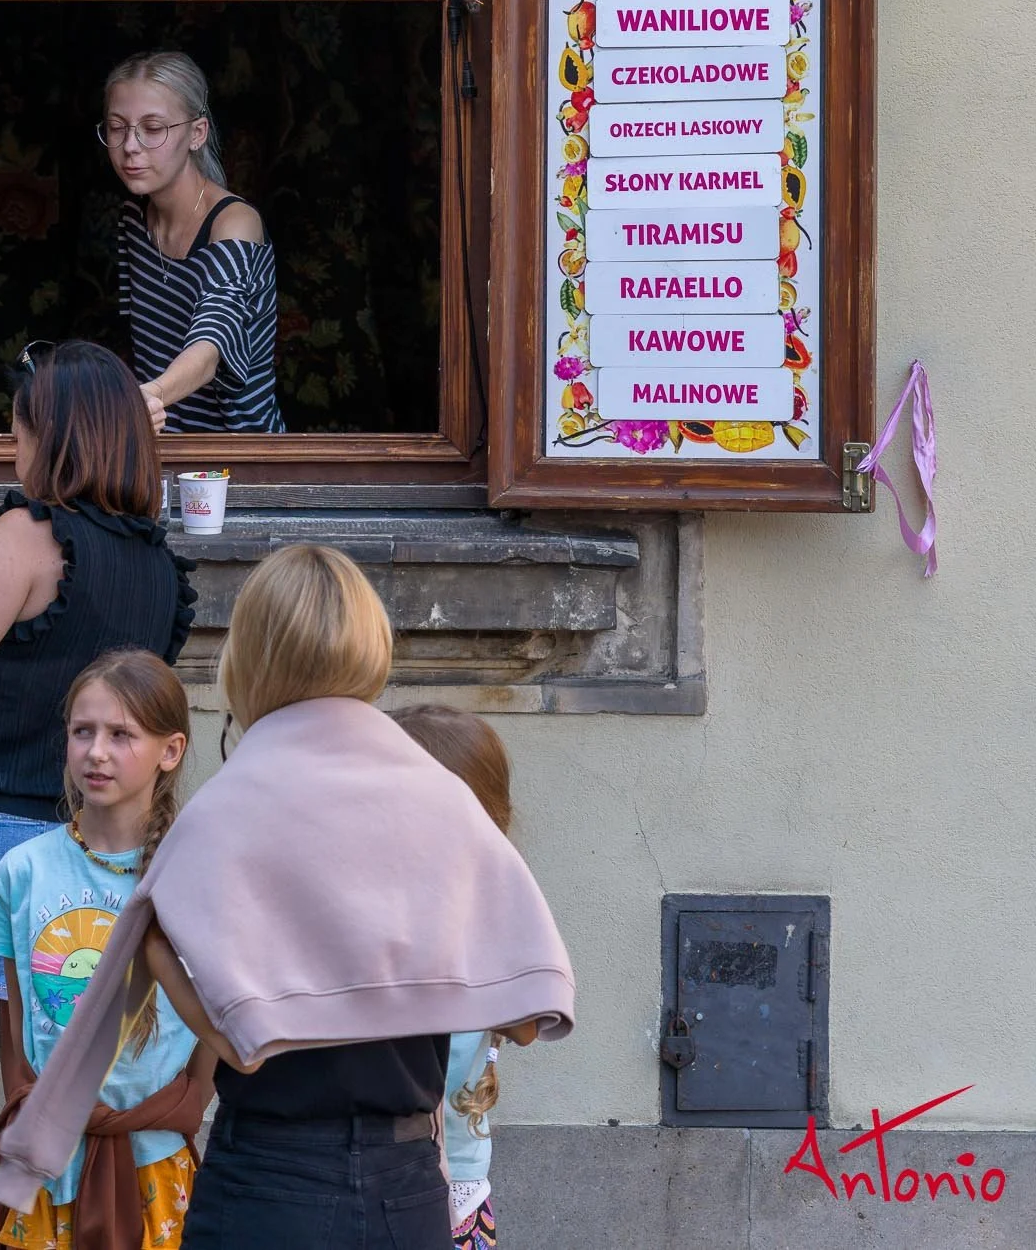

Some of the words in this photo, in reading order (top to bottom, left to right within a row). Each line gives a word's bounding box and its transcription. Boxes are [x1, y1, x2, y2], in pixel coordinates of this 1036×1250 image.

[617, 9, 769, 31] WANILIOWE
[612, 63, 768, 85] CZEKOLADOWE
[610, 122, 676, 137] ORZECH
[682, 120, 762, 135] LASKOWY
[606, 173, 673, 192] SŁONY
[680, 172, 763, 190] KARMEL
[623, 223, 742, 245] TIRAMISU
[621, 277, 742, 298] RAFAELLO
[629, 331, 744, 351] KAWOWE
[633, 384, 758, 403] MALINOWE
